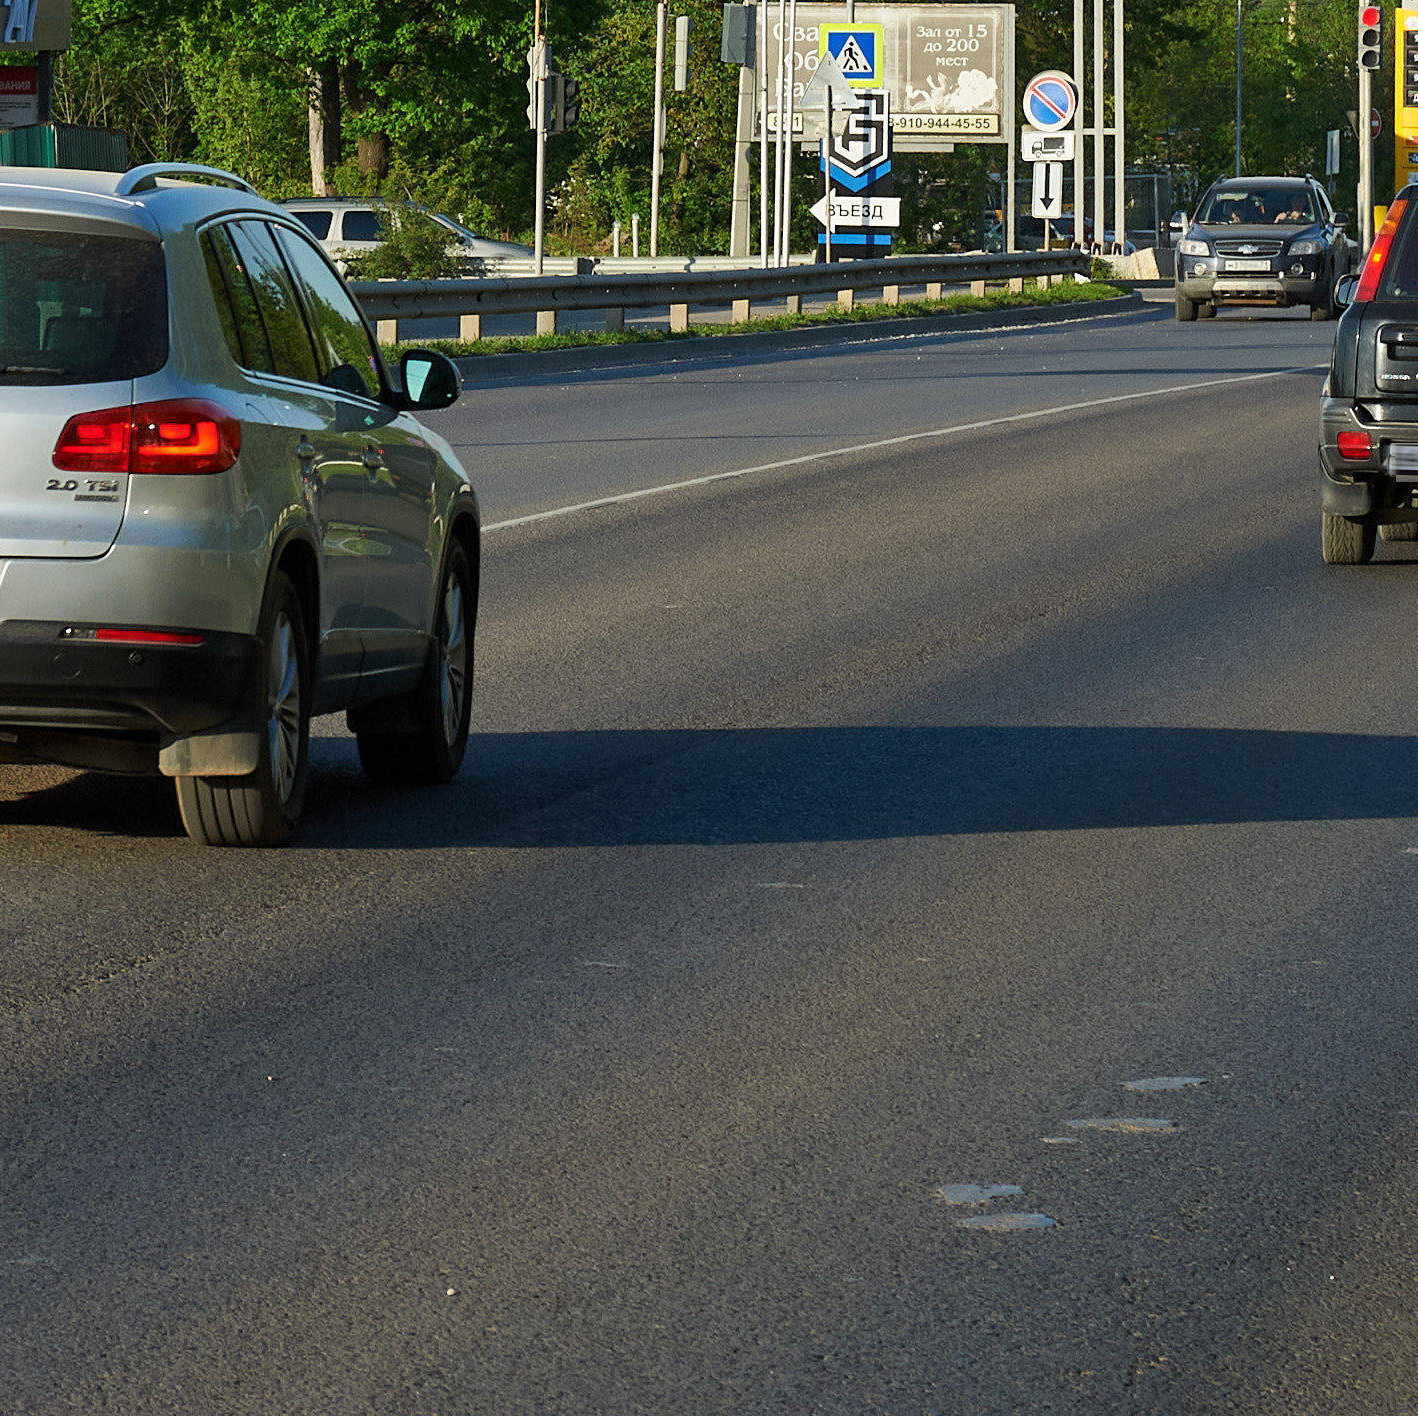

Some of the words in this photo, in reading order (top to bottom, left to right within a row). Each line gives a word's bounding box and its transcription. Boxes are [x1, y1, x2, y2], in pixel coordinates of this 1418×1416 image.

[916, 25, 941, 38] Зал
[945, 28, 962, 38] от
[968, 24, 988, 38] 15
[923, 42, 943, 53] до
[946, 38, 980, 53] 200
[935, 56, 969, 66] мест
[827, 204, 883, 220] ВЪЕЗД
[46, 479, 79, 491] 2.0
